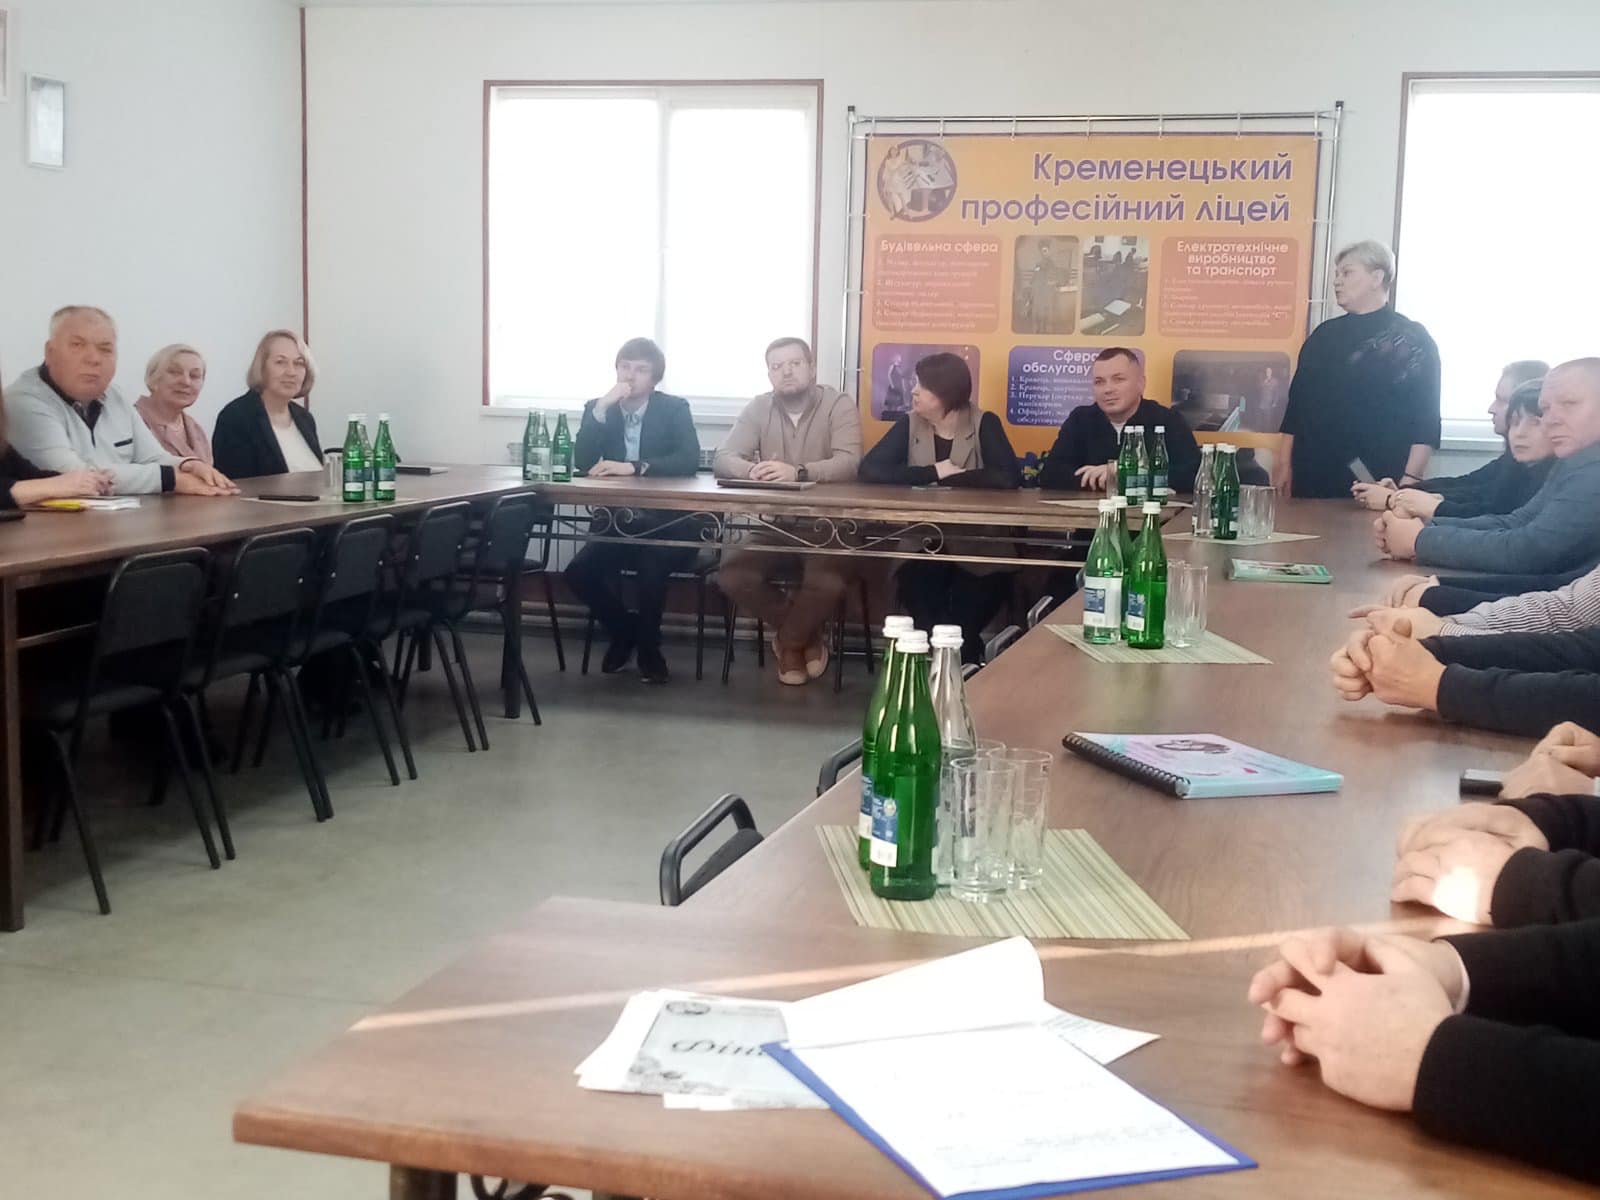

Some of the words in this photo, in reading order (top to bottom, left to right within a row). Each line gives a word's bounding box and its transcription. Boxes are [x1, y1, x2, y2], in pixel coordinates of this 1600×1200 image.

[1033, 151, 1293, 185] Кременецький
[961, 192, 1186, 226] професійний
[1195, 192, 1291, 226] ліцей
[880, 239, 952, 254] Будівельна
[954, 241, 999, 255] сфера
[1177, 240, 1289, 254] Електротехнічне
[1187, 252, 1276, 266] виробництво
[1185, 265, 1201, 276] та
[1205, 265, 1278, 278] транспорт
